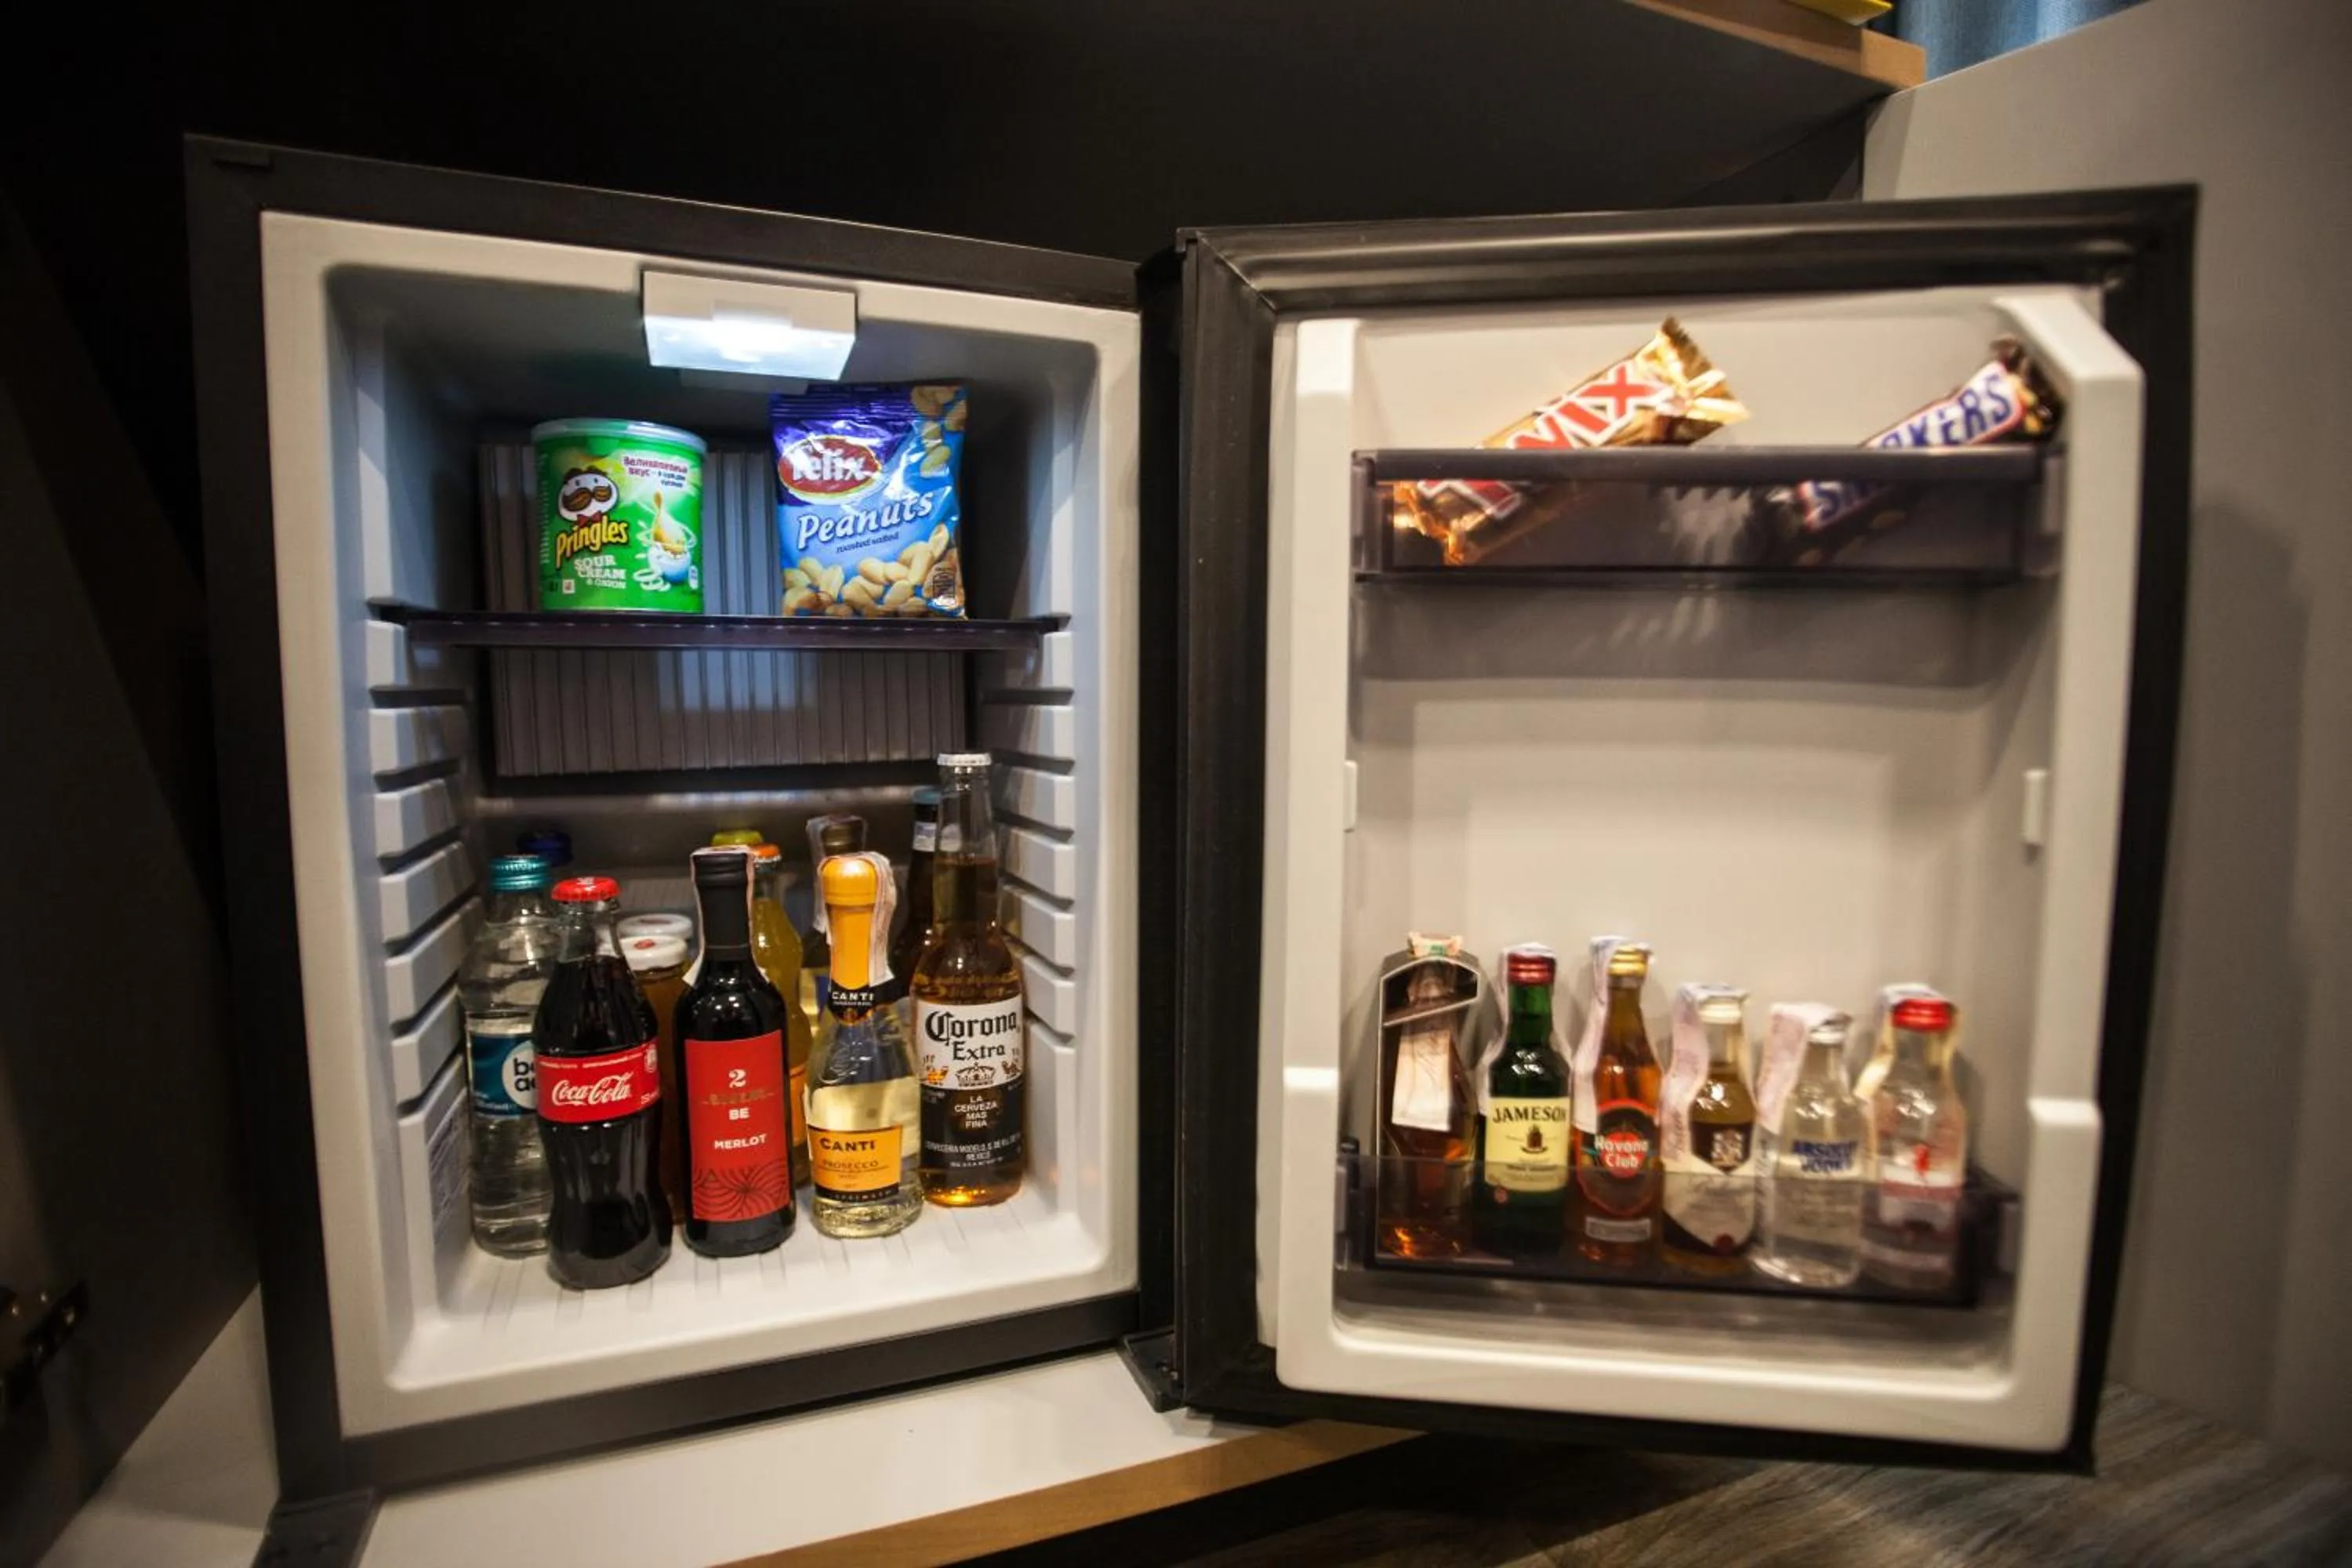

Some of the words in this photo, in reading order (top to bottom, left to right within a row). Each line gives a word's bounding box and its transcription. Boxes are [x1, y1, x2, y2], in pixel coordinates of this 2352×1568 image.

[797, 491, 935, 550] Peanuts
[556, 515, 628, 569] Pringles
[574, 554, 616, 571] SOUR
[832, 991, 876, 1002] CANTI
[924, 1011, 1018, 1047] Corona
[953, 1040, 1006, 1061] Extra
[728, 1068, 747, 1089] 2
[552, 1071, 634, 1106] Coca-Cola
[954, 1101, 998, 1112] CERVEZA
[969, 1095, 984, 1104] LA
[728, 1106, 751, 1120] BE
[713, 1133, 768, 1150] MERLOT
[819, 1138, 877, 1152] CANTI
[1605, 1152, 1640, 1168] Club
